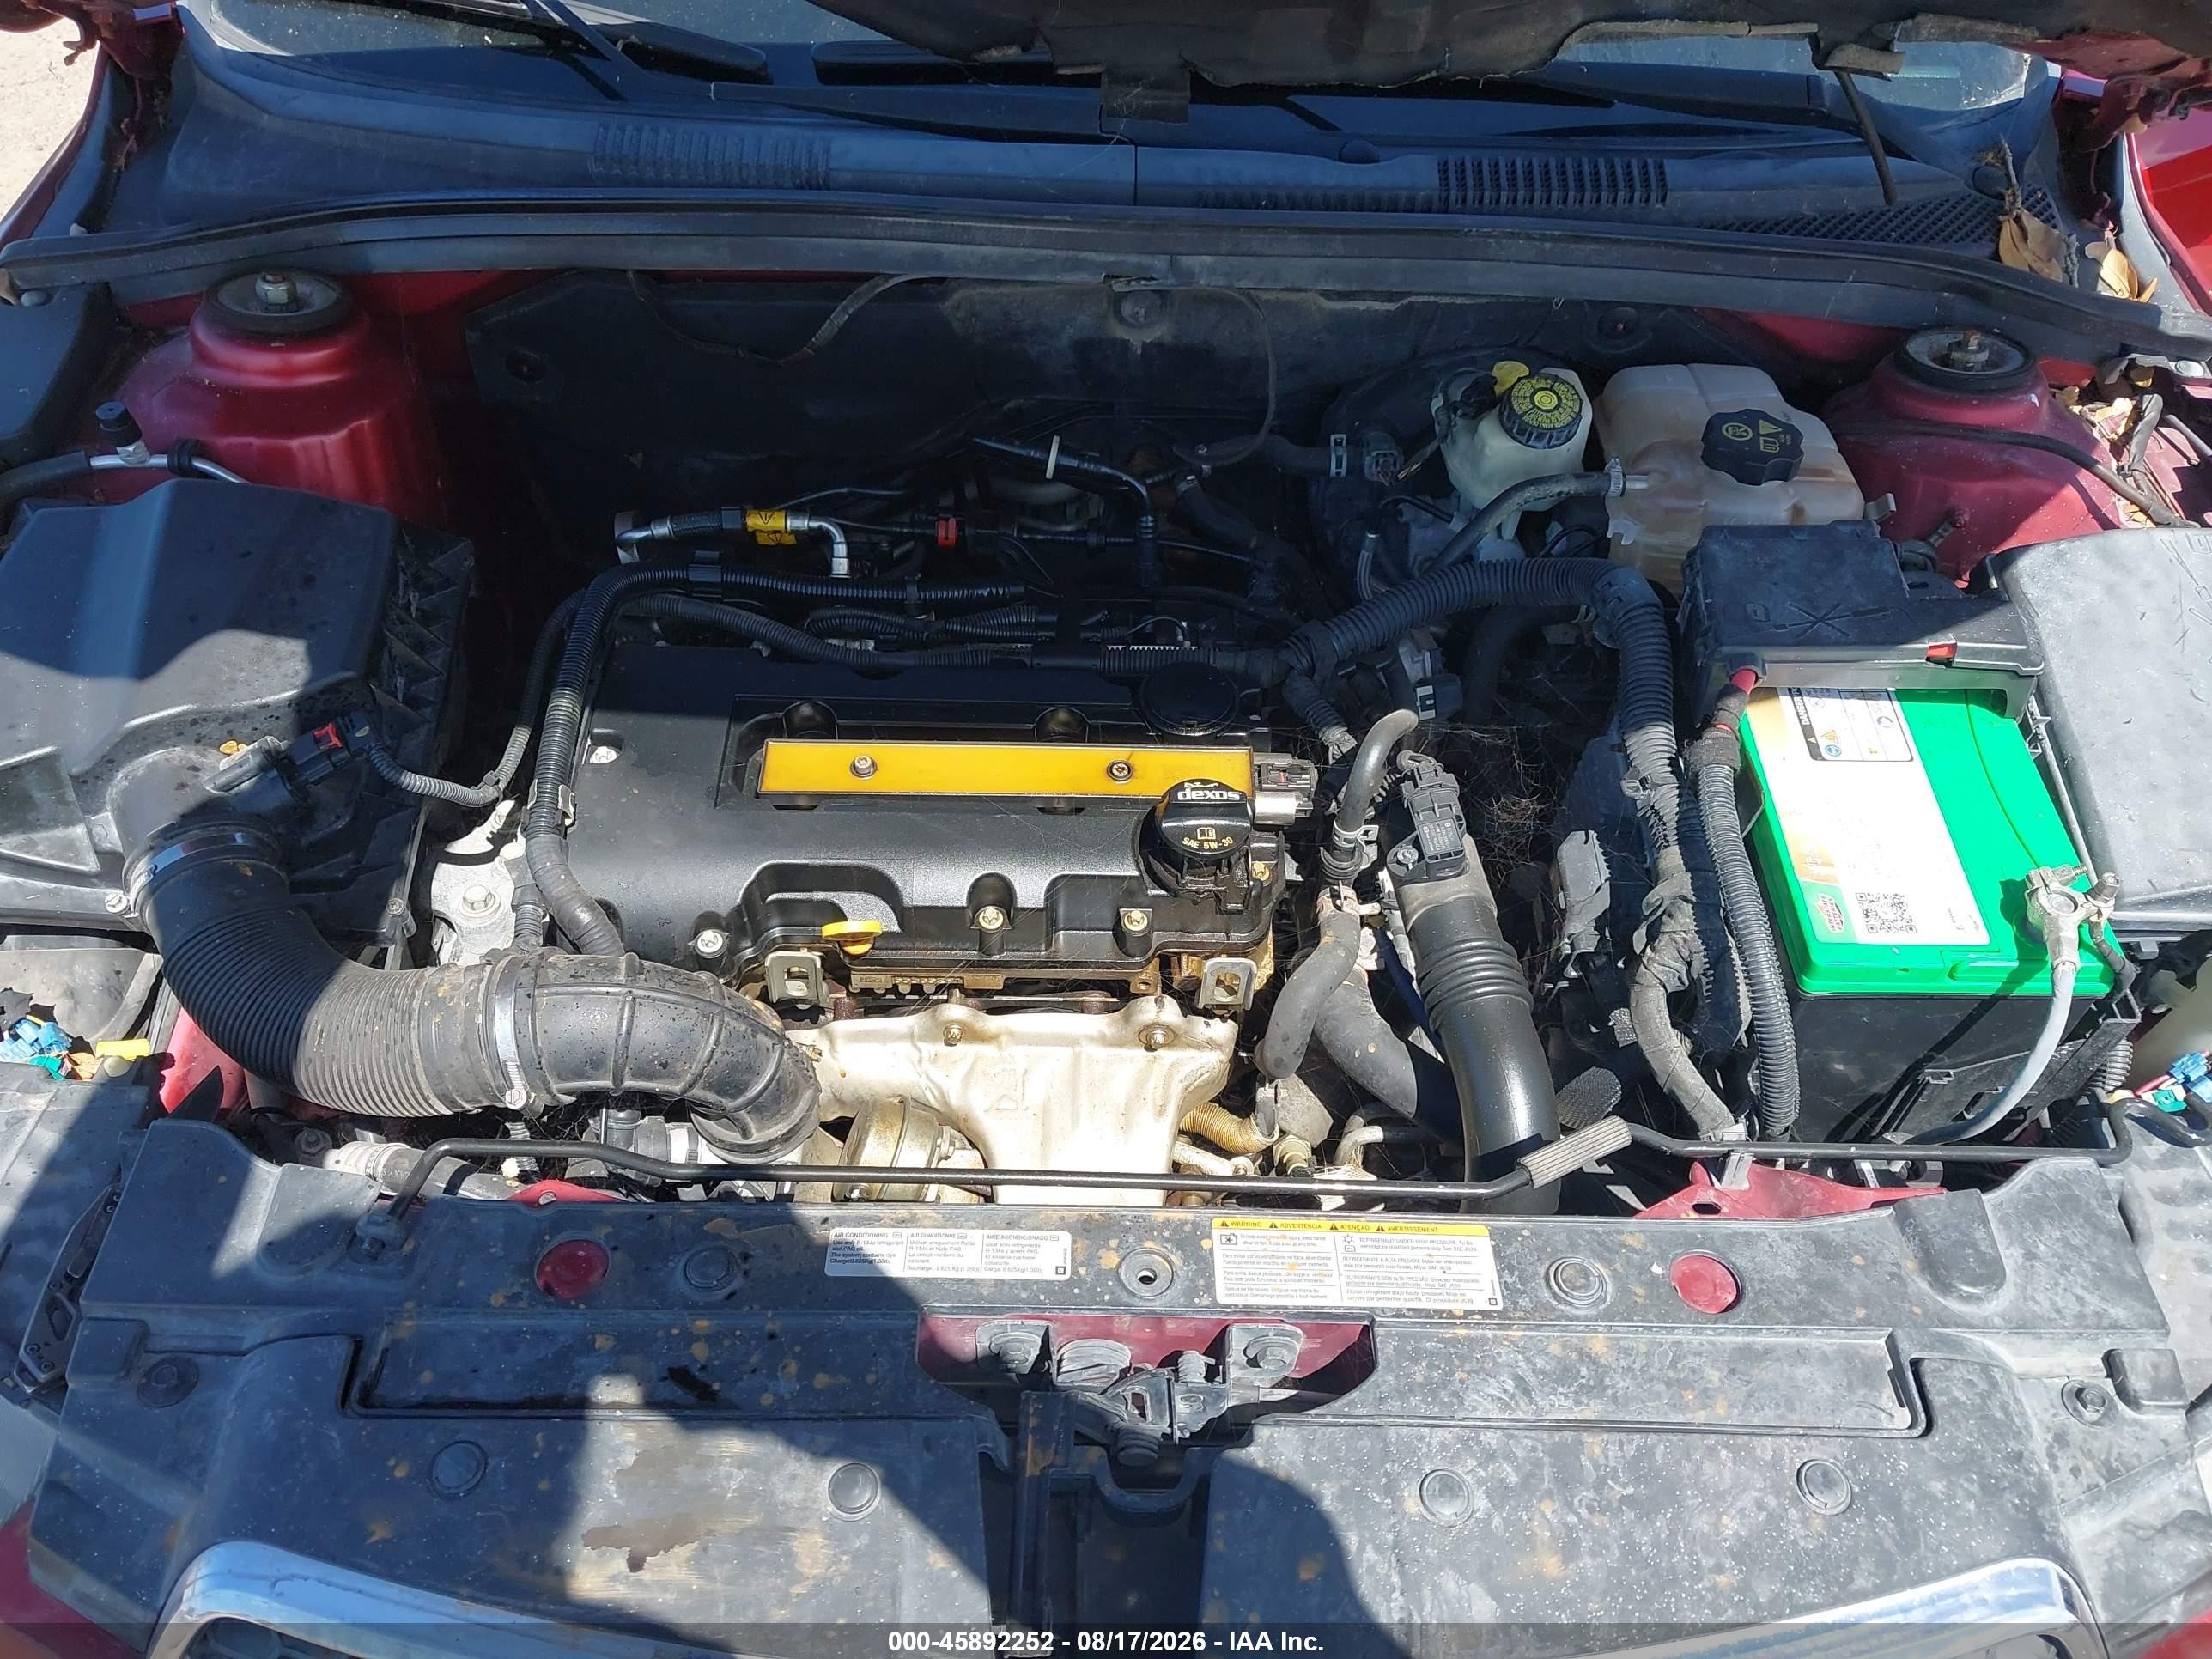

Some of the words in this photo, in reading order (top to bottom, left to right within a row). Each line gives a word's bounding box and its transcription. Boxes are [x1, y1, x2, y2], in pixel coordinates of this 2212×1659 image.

[1177, 788, 1242, 800] dexos
[1182, 836, 1200, 849] SAE
[1204, 836, 1234, 850] 5W-30
[1820, 895, 1836, 932] INTERSTATE
[1828, 897, 1842, 931] BATTERIES
